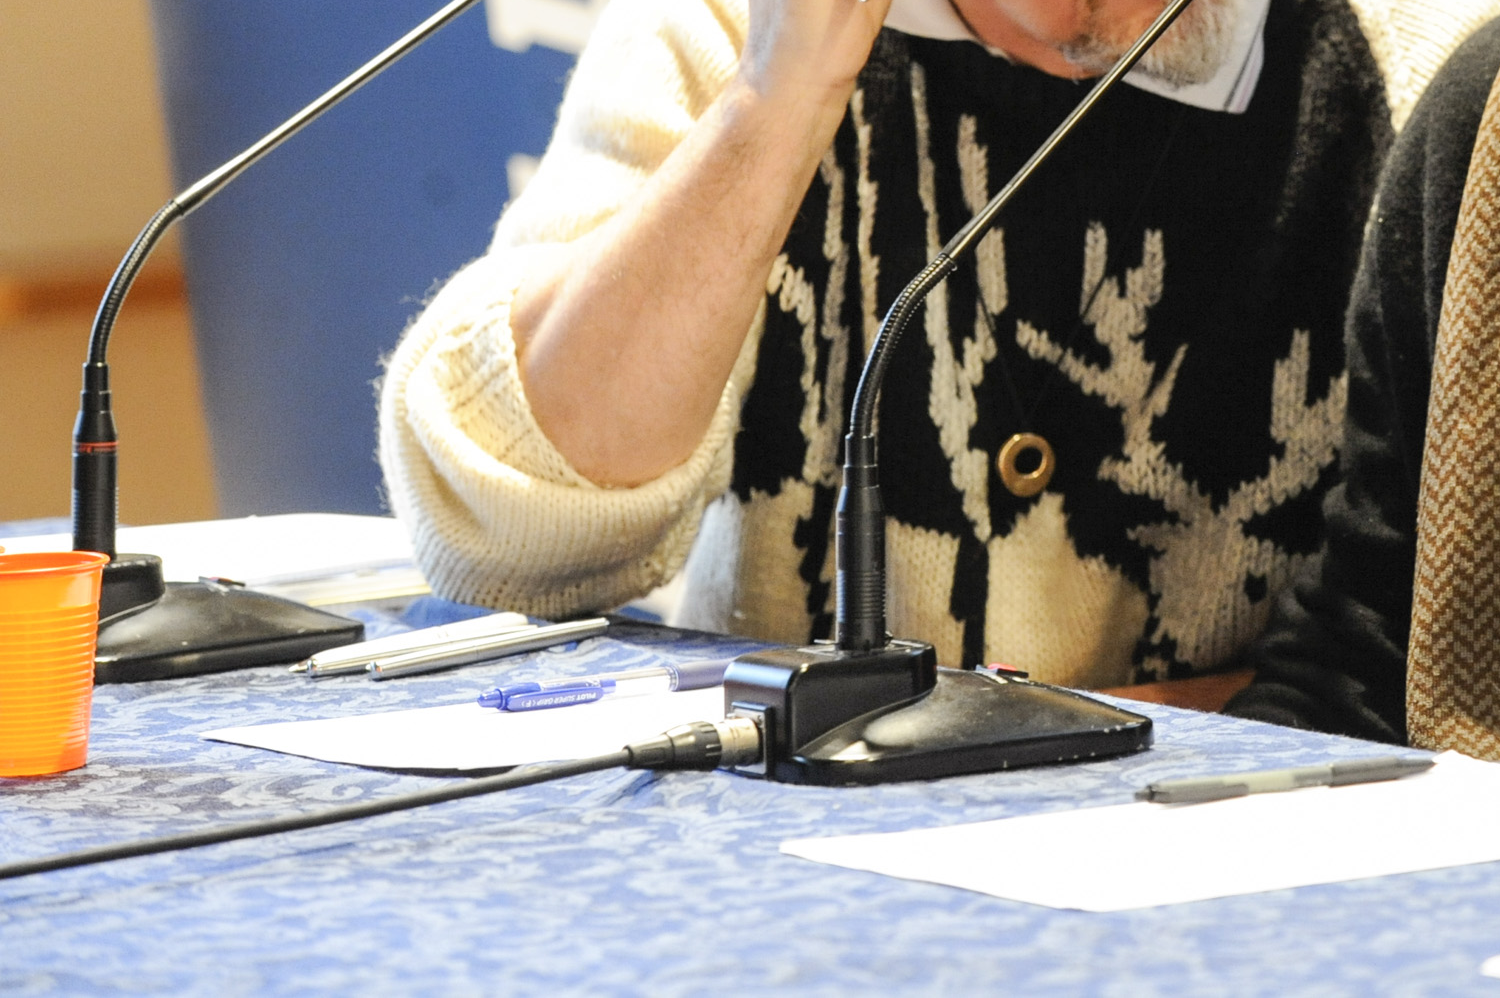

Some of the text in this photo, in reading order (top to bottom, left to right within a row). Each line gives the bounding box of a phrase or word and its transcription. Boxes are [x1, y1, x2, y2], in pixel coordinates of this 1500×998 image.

[554, 694, 576, 703] SUPER
[576, 692, 597, 701] PILOT
[537, 697, 554, 706] GRIP
